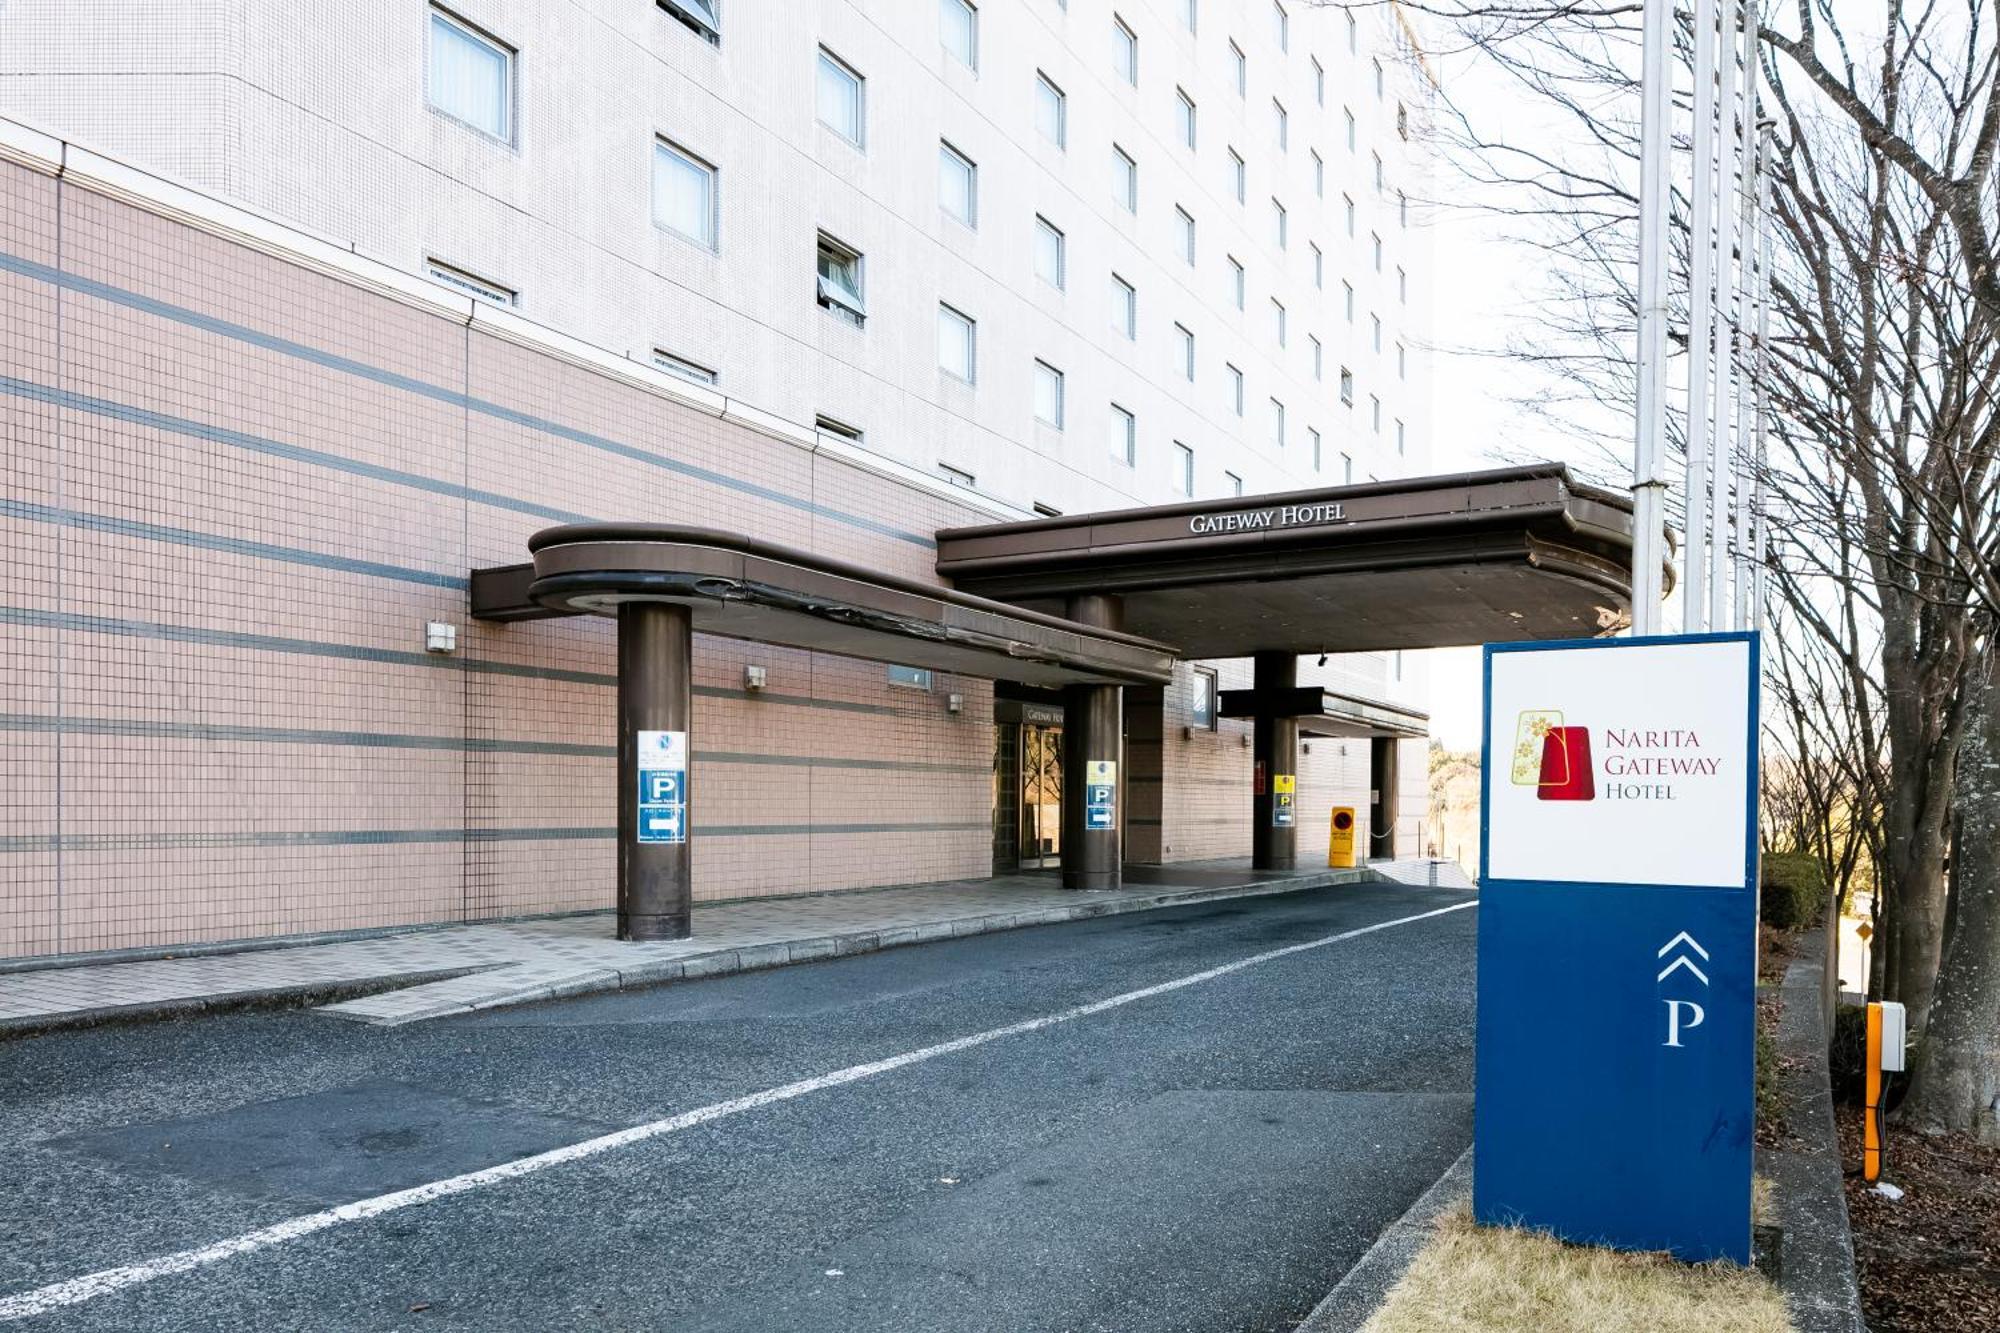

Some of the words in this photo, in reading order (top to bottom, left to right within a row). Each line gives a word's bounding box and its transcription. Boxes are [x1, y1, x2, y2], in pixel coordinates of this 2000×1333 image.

[1189, 511, 1276, 534] GATEWAY
[1281, 503, 1346, 525] HOTEL
[1606, 729, 1700, 749] NARITA
[1604, 755, 1722, 776] GATEWAY
[653, 777, 676, 798] P
[1095, 789, 1109, 802] P
[1606, 783, 1678, 800] HOTEL
[1280, 796, 1290, 806] P
[1661, 1000, 1705, 1048] P
